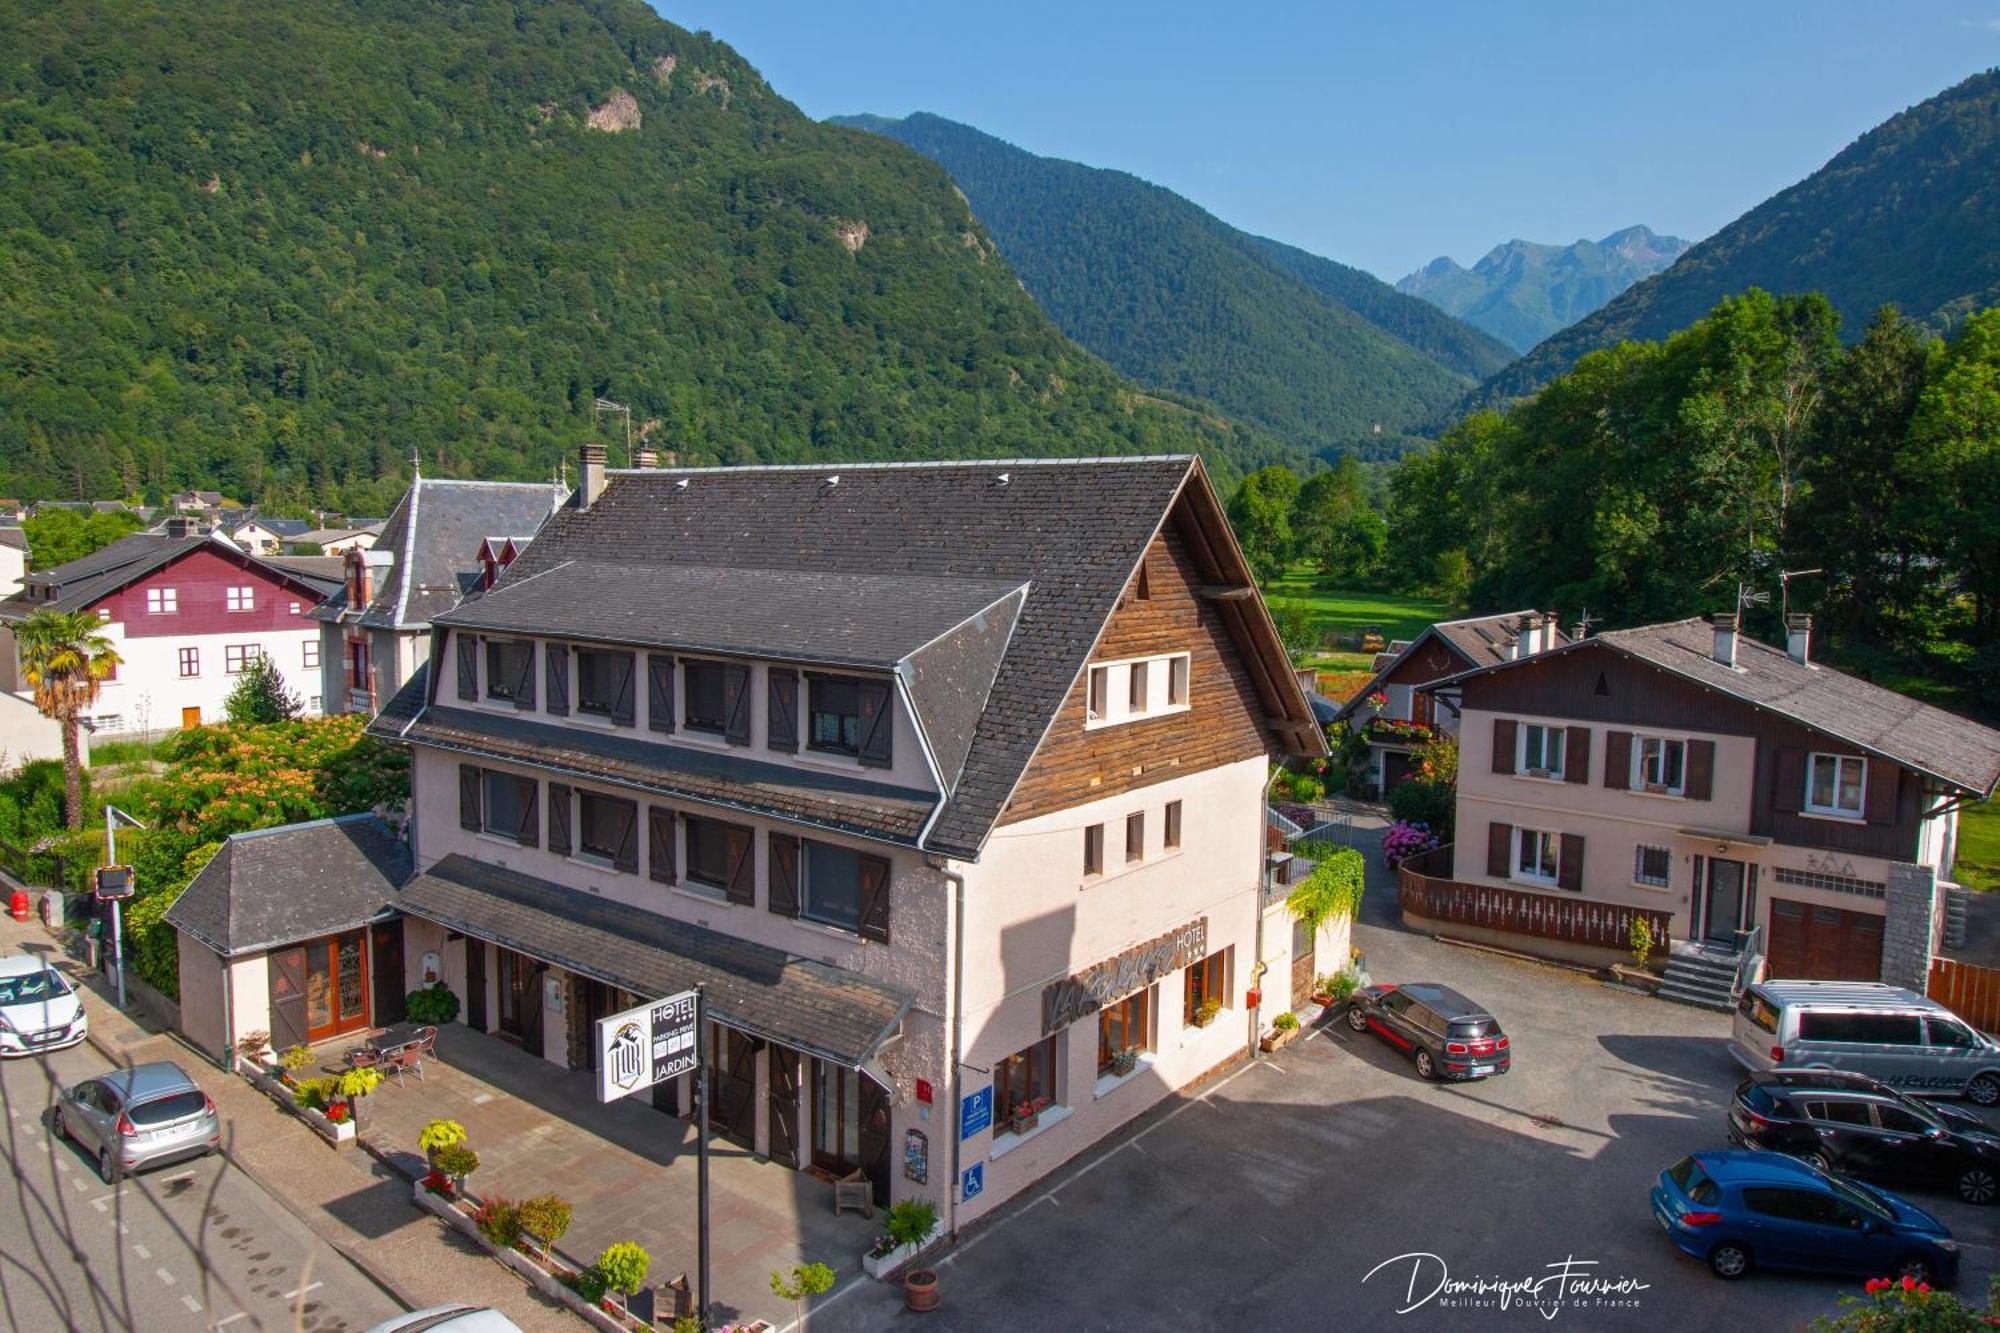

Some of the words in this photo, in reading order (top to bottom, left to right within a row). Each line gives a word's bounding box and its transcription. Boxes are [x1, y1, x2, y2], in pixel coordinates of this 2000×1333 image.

[1176, 925, 1204, 951] HOTEL
[652, 998, 694, 1024] HOTEL
[655, 1053, 694, 1081] JARDIN
[973, 1095, 981, 1109] P
